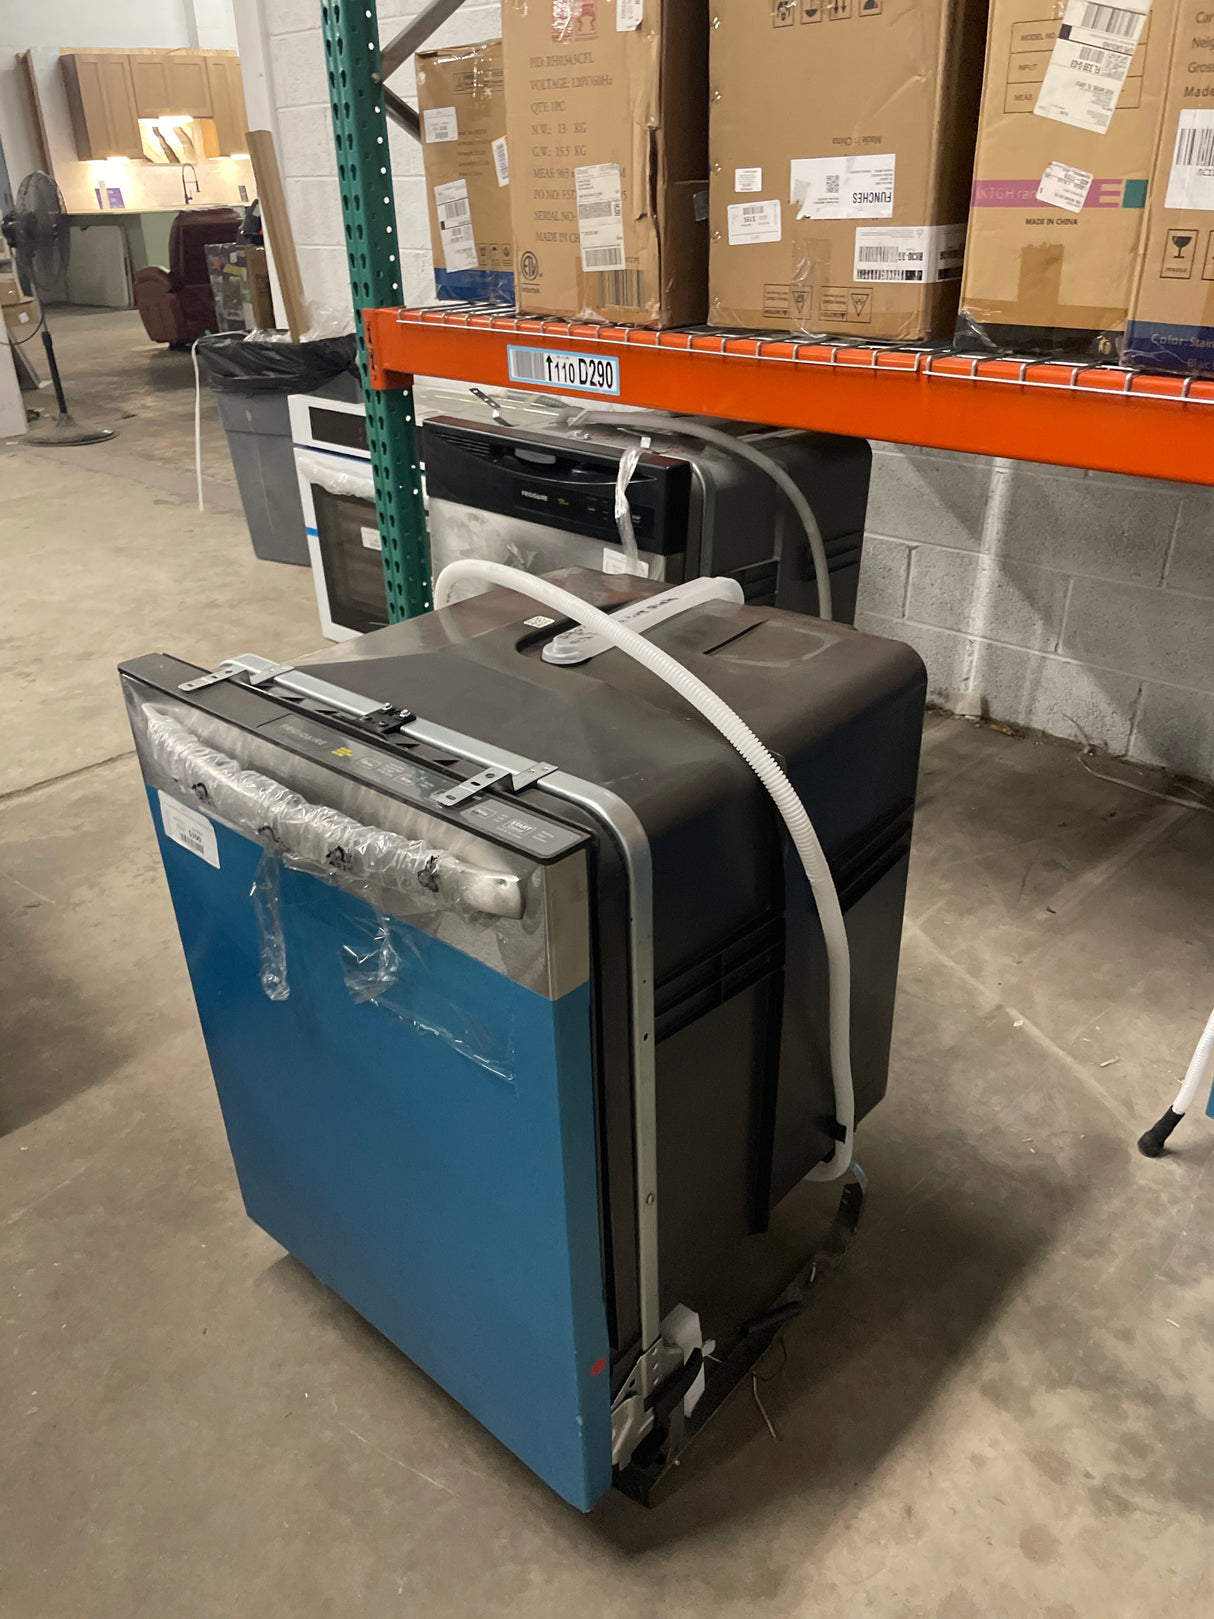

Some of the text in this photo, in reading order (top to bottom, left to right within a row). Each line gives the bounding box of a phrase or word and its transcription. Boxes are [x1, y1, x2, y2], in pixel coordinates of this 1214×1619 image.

[1183, 86, 1214, 98] Made
[574, 122, 587, 133] KG
[574, 145, 587, 156] KG
[534, 190, 545, 200] PO
[852, 191, 892, 204] FUNCHES
[534, 211, 560, 221] SERIAL
[1025, 218, 1078, 226] MADE IN CHINA
[535, 232, 558, 242] MADE
[554, 358, 613, 389] 110 D290
